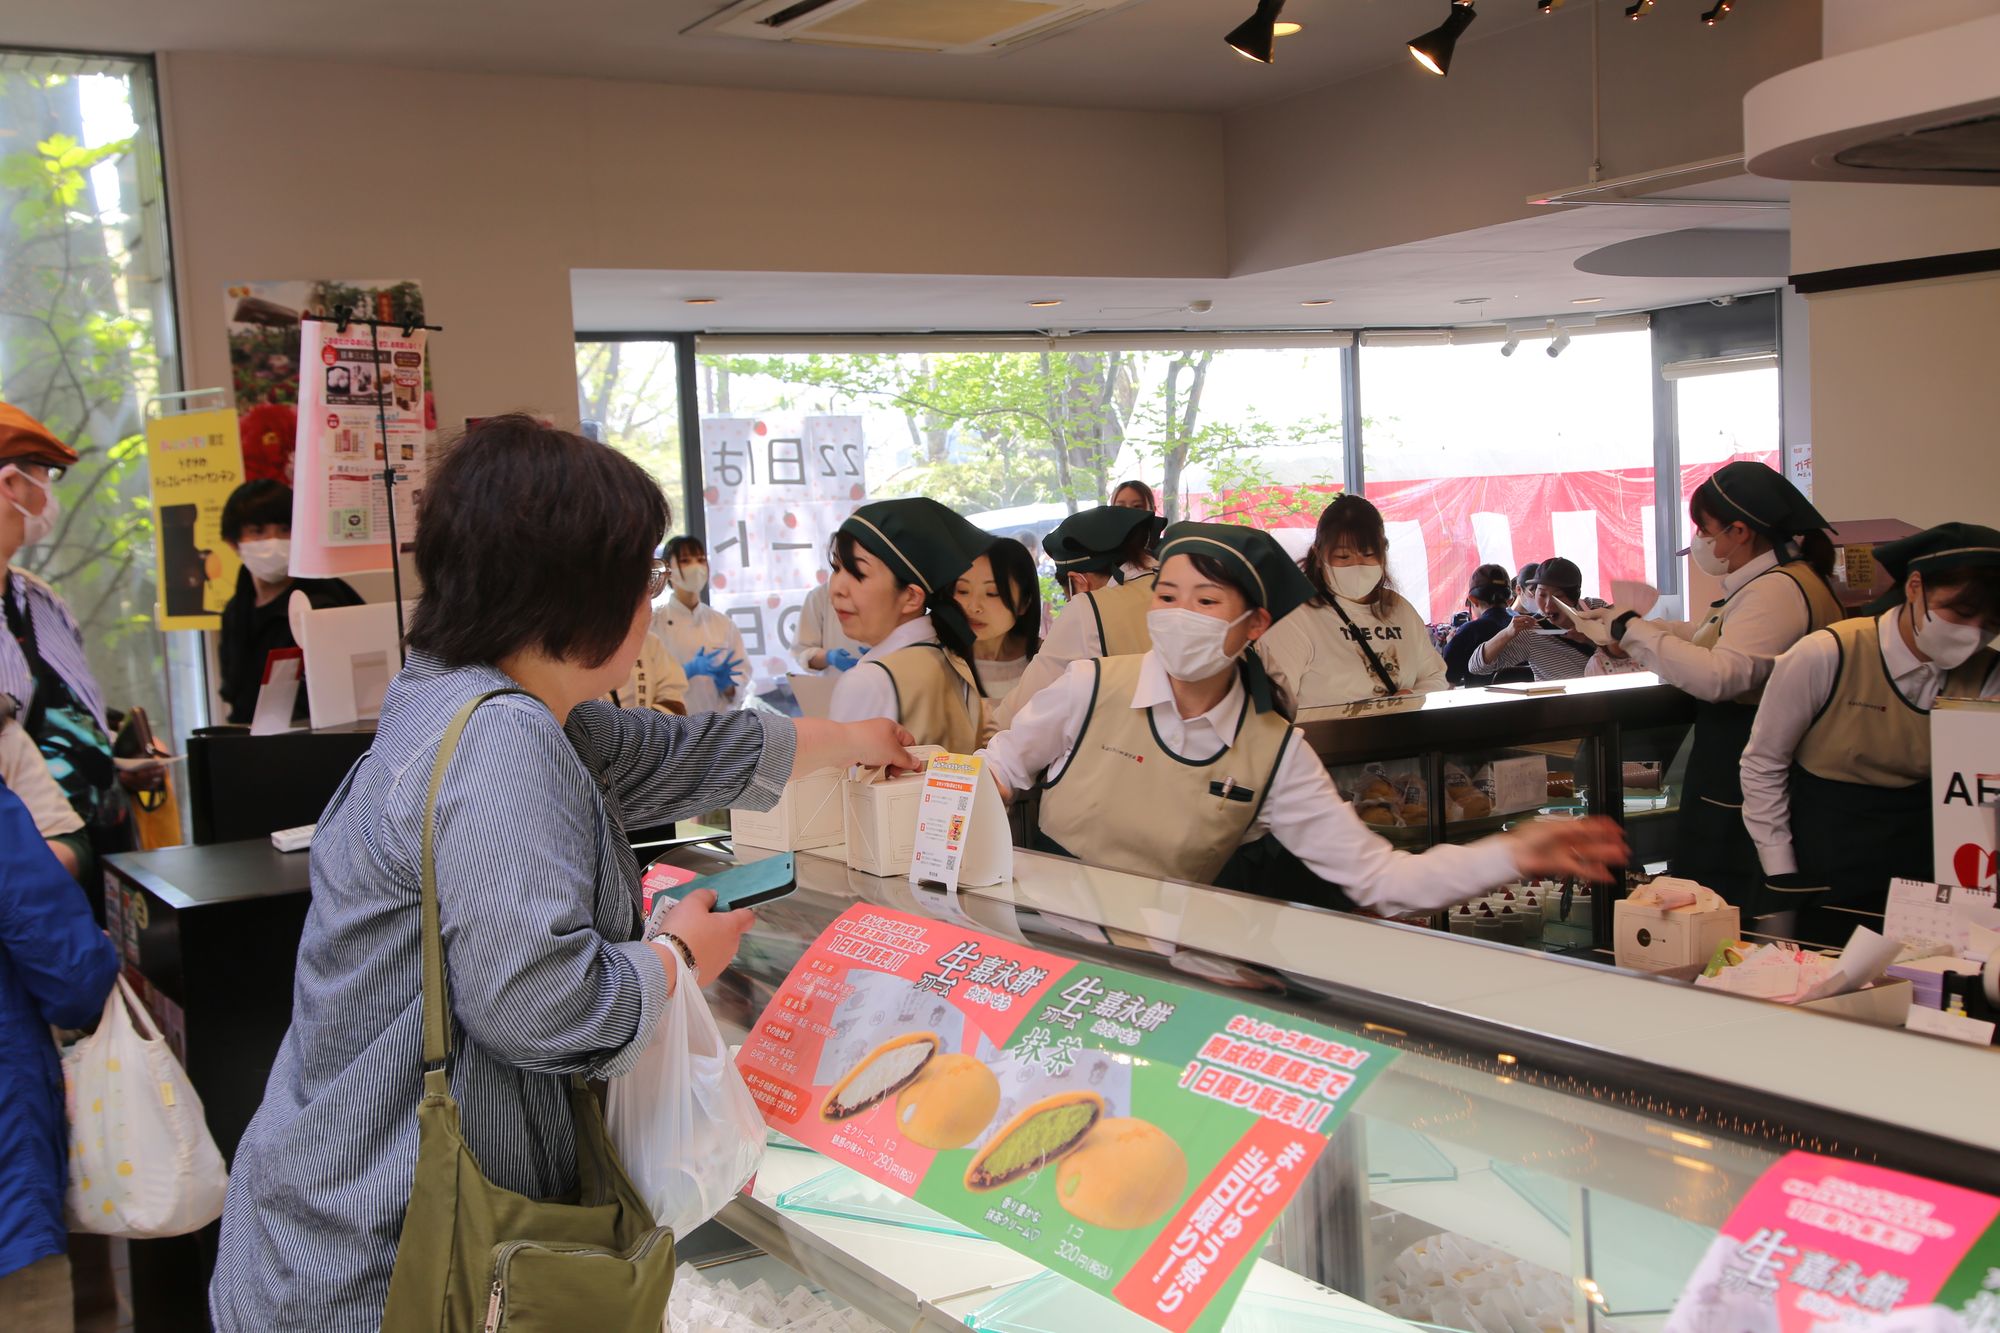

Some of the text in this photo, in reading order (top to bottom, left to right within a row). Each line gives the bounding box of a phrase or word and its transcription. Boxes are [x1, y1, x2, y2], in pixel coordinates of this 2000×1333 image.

[1340, 626, 1402, 641] TE CAT
[1938, 888, 1948, 902] 4
[828, 934, 909, 971] 1日限り販売!!
[922, 942, 1049, 997] 生 嘉永餅
[1046, 977, 1175, 1032] 生 嘉永餅
[1013, 1027, 1082, 1076] 抹茶
[1197, 1033, 1356, 1100] 開成柏屋限定で
[1225, 1014, 1370, 1069] まんじゅう祭り記念!
[1178, 1060, 1334, 1134] 1日限り販売!!
[1152, 1145, 1270, 1284] 当日限り!
[1156, 1141, 1306, 1313] まんじゅう祭り
[1738, 1226, 1798, 1290] 生
